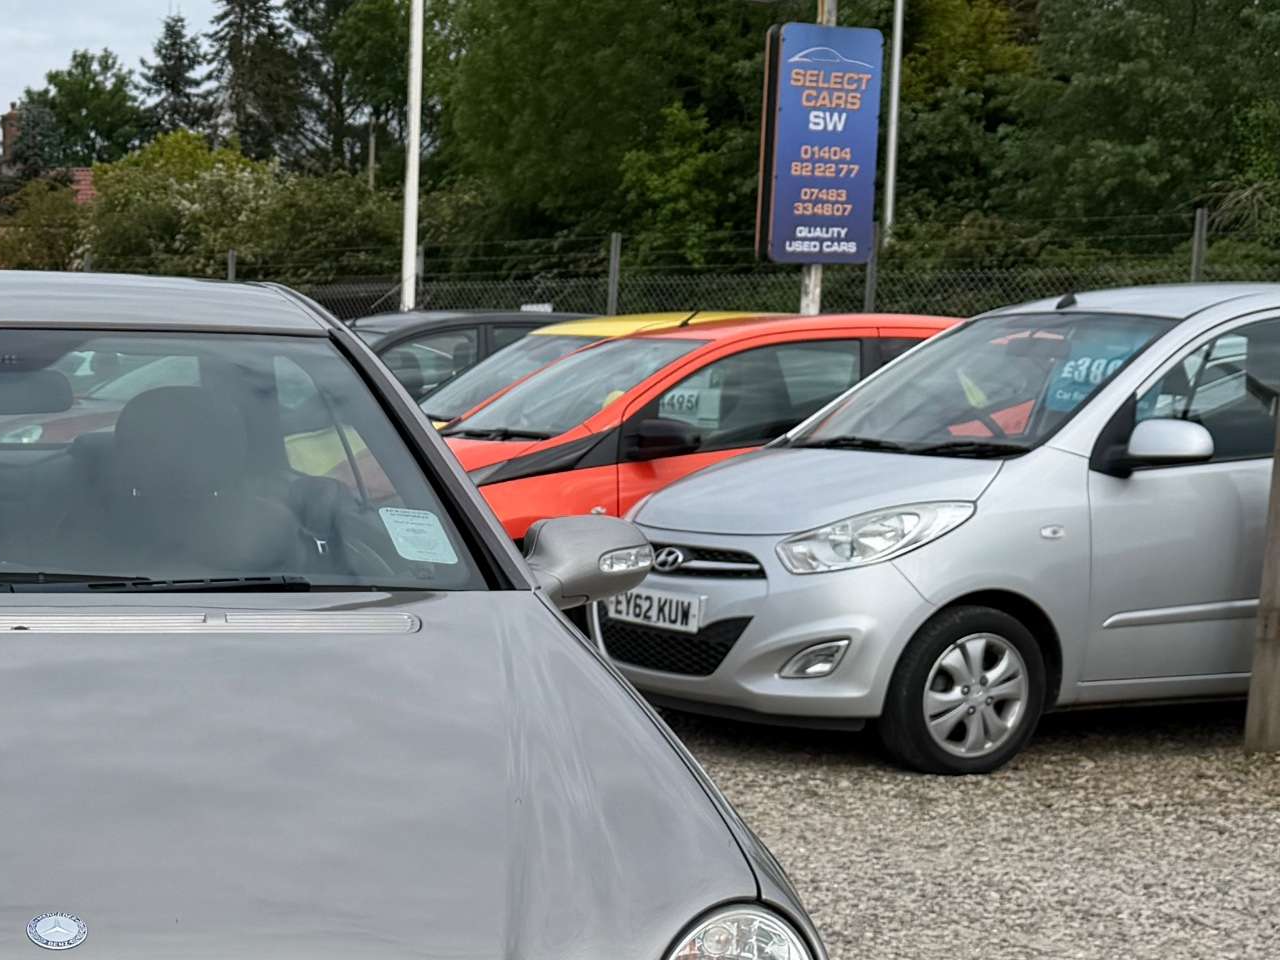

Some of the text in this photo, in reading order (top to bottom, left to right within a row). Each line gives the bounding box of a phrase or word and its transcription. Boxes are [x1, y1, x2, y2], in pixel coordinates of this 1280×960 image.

[790, 69, 871, 89] SELECT
[802, 90, 861, 109] CARS
[808, 111, 847, 131] SW
[800, 145, 852, 160] 01404
[800, 188, 847, 201] 07483
[793, 203, 853, 216] 334807
[796, 226, 848, 238] QUALITY
[786, 241, 857, 252] USED CARS
[657, 597, 691, 626] KUW
